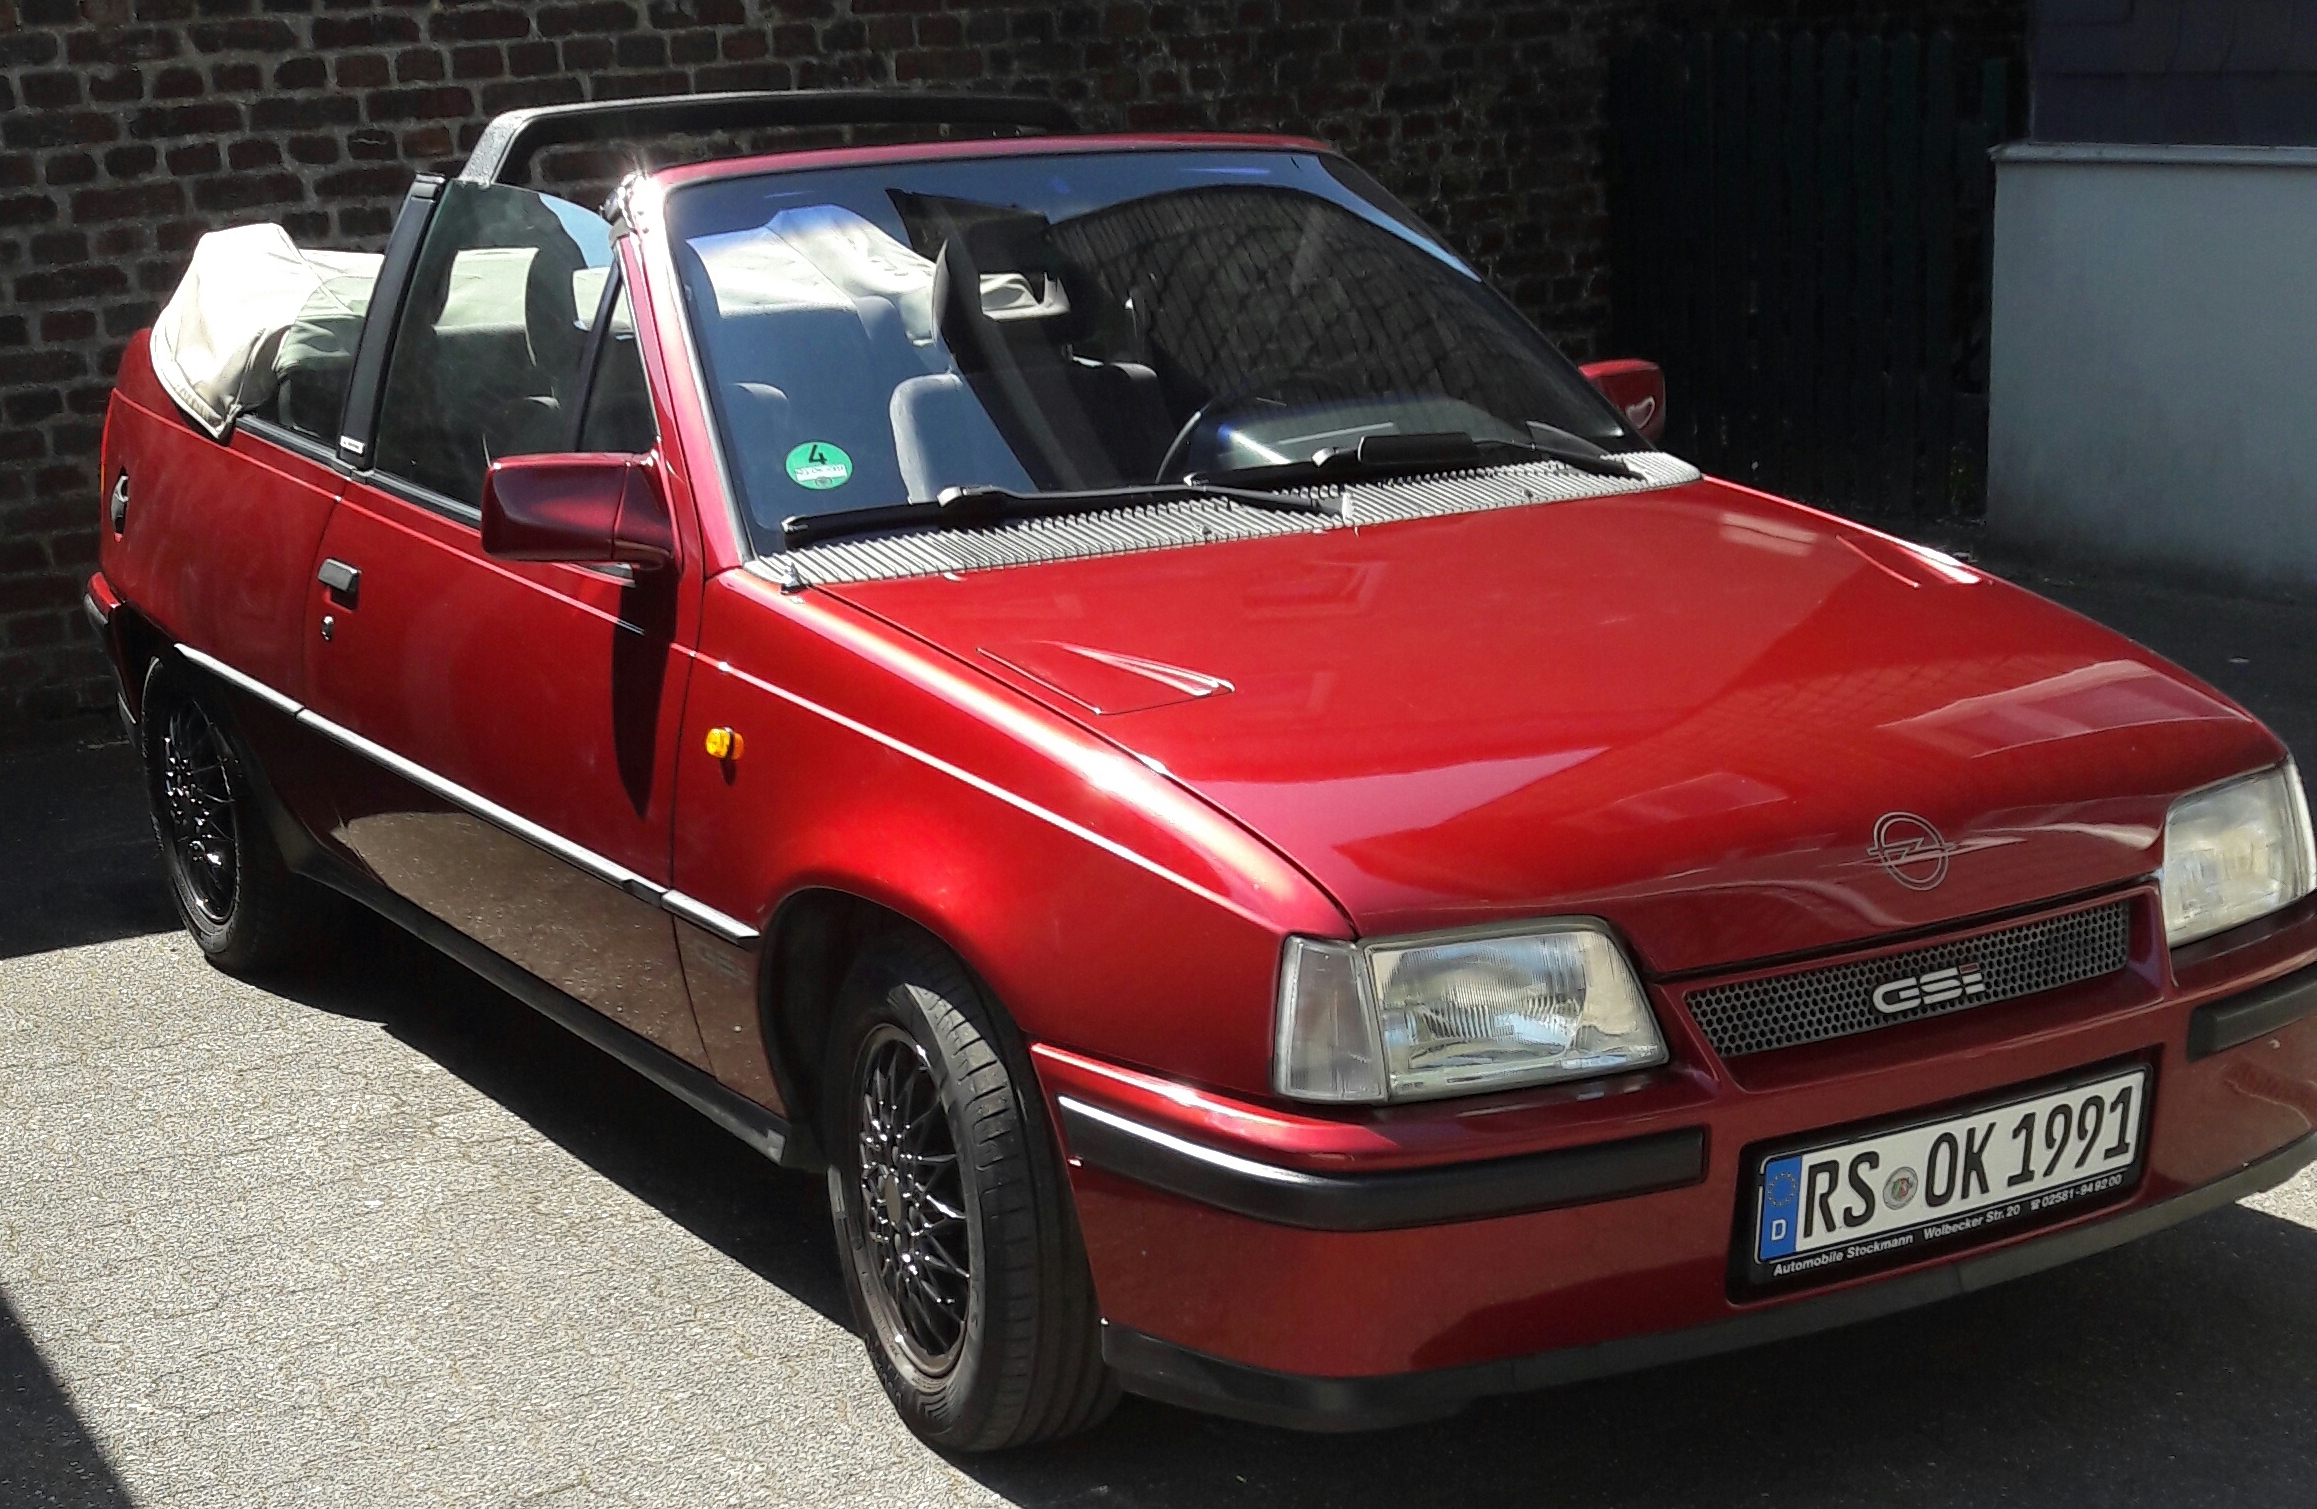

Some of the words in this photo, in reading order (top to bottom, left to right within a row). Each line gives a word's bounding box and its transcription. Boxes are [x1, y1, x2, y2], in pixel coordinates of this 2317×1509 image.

[808, 443, 828, 465] 4
[1804, 1150, 1880, 1238] RS
[1925, 1122, 1997, 1208] OK
[2007, 1086, 2133, 1188] 1991
[1771, 1218, 1787, 1241] D
[1773, 1251, 1843, 1276] Automobile
[1846, 1234, 1914, 1259] Stockmann
[1923, 1216, 1983, 1240] Wolbecker
[1985, 1209, 2005, 1223] Str.
[2006, 1204, 2021, 1219] 20
